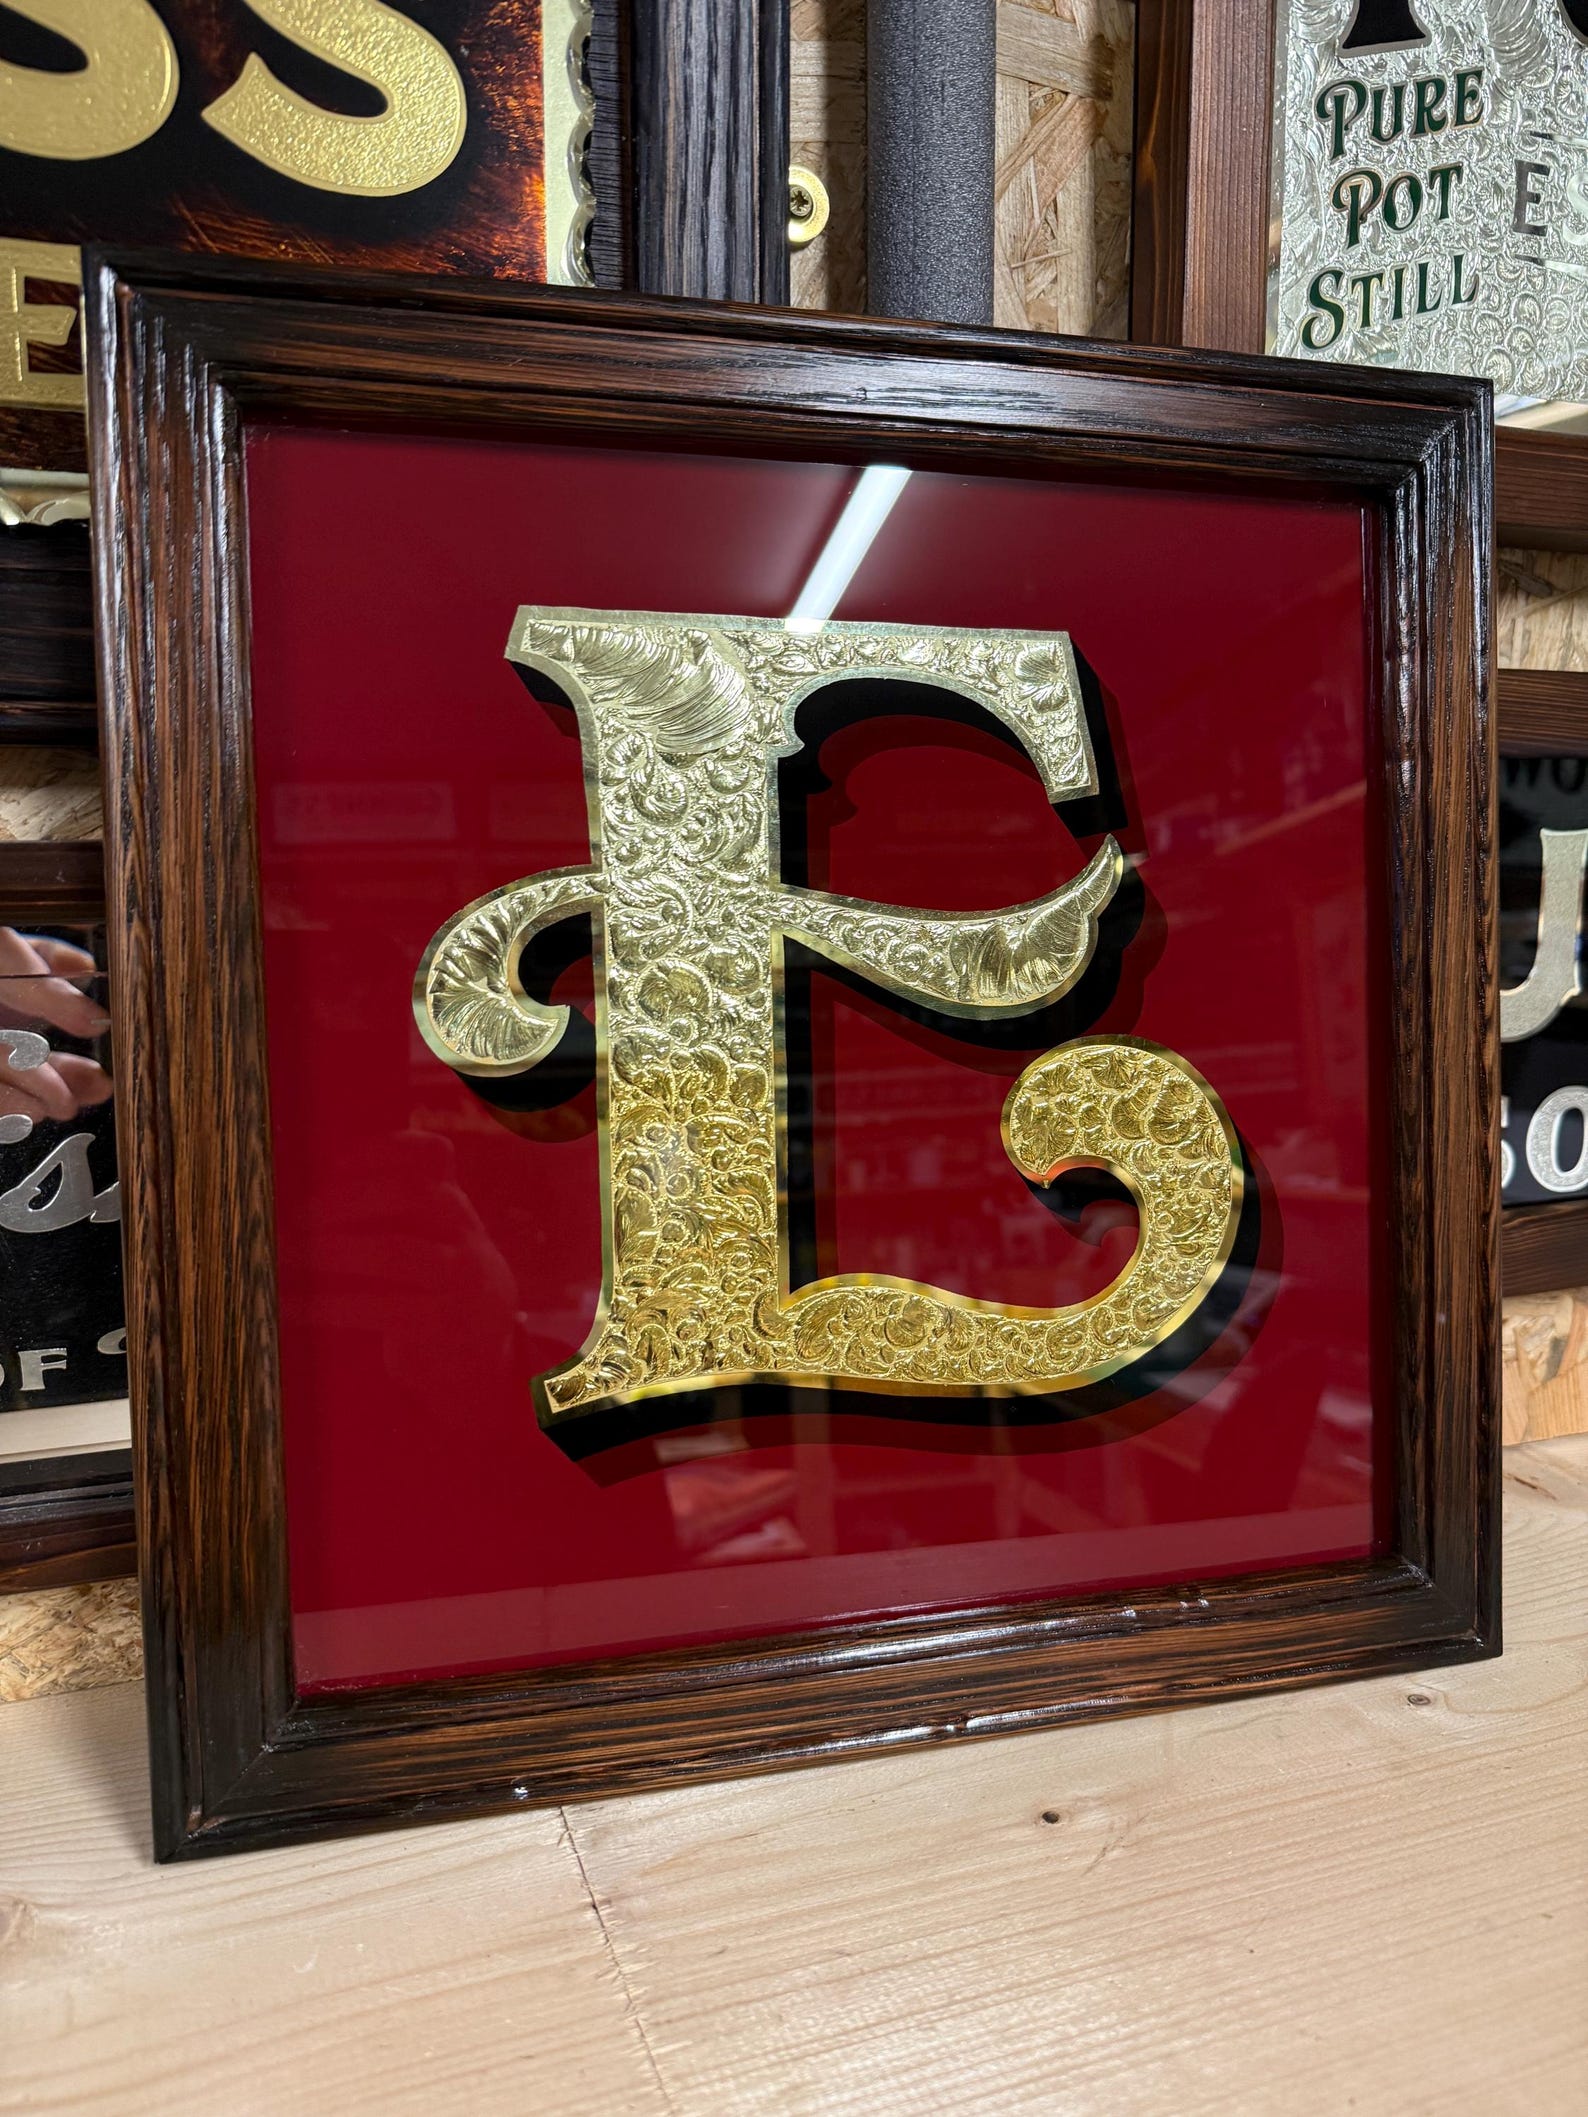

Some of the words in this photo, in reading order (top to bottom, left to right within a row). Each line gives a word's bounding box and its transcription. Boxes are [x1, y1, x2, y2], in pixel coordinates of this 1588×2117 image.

[1315, 66, 1485, 161] PURE
[1330, 162, 1464, 250] POT
[1301, 254, 1479, 350] STILL
